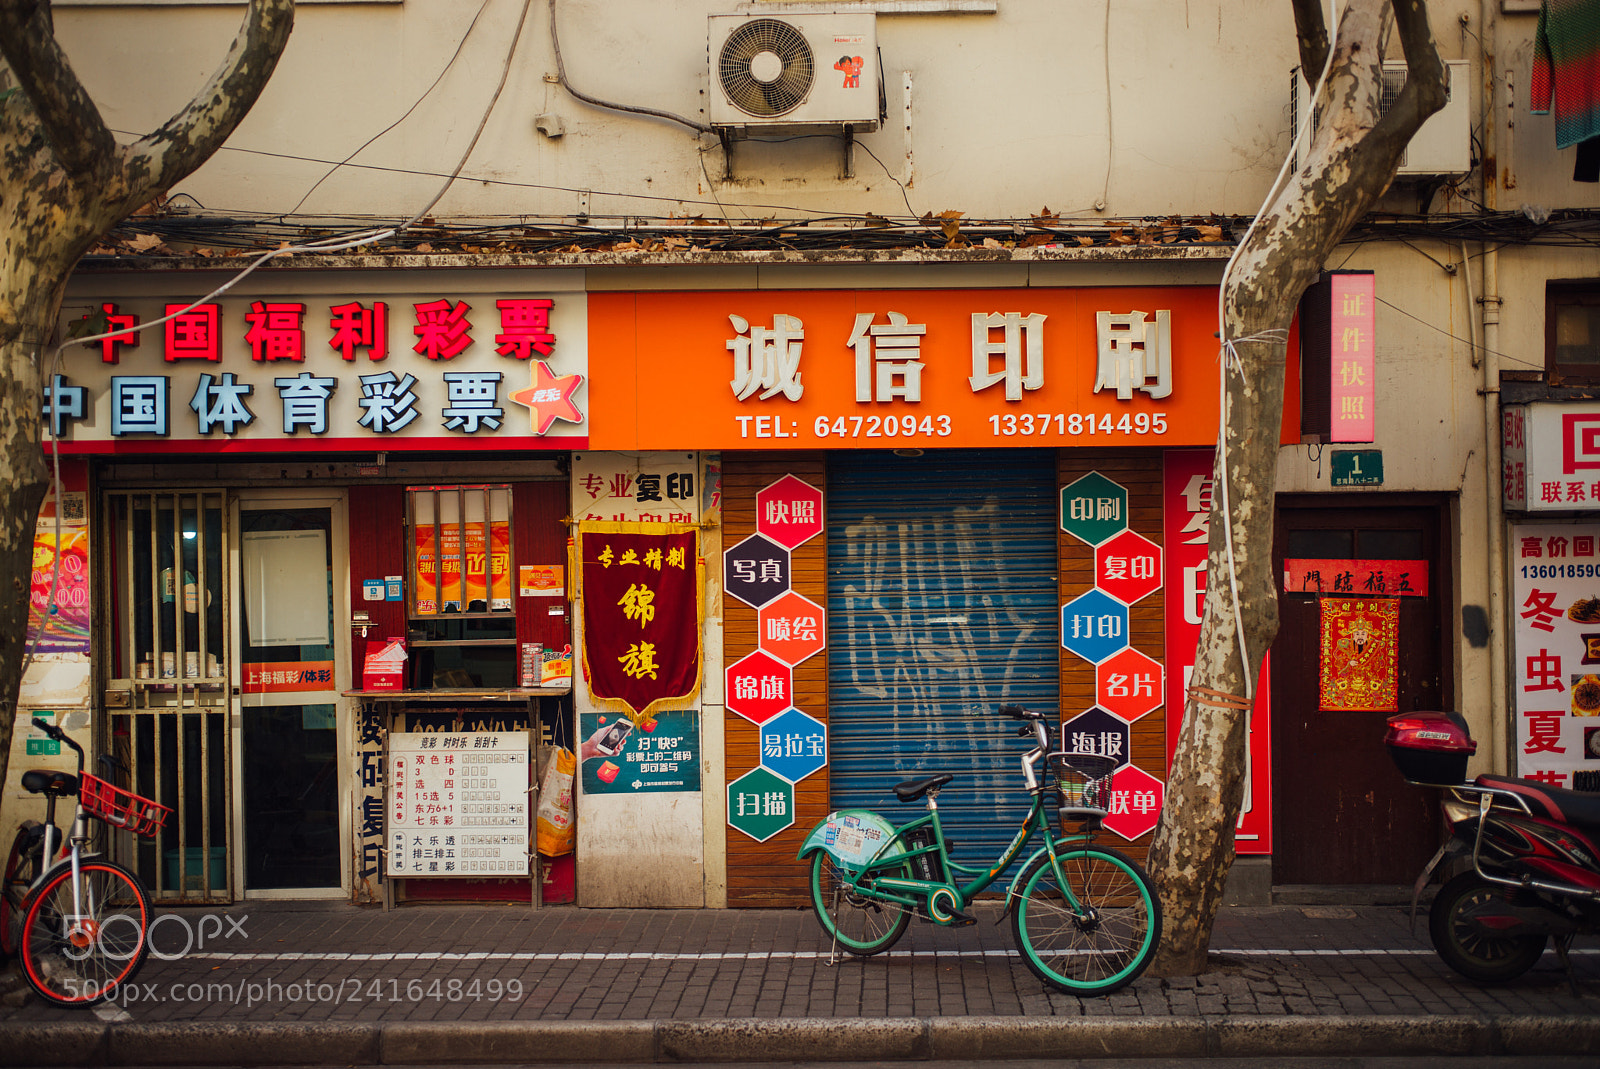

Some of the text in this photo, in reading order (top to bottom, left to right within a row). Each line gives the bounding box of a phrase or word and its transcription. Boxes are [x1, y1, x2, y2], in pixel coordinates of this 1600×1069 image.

[83, 299, 555, 364] 中国福利彩票
[726, 309, 1173, 403] 诚信印刷
[1340, 293, 1366, 420] 证件快照
[42, 371, 505, 437] 中国体育彩票
[735, 413, 1168, 438] TEL: 64720943 13371814495
[1351, 455, 1362, 475] 1
[766, 500, 815, 525] 快照
[1070, 497, 1120, 521] 印刷
[1521, 536, 1600, 558] 高价回
[733, 558, 783, 583] 写真
[1104, 555, 1154, 580] 复印
[767, 617, 817, 641] 喷绘
[1070, 614, 1121, 638] 打印
[246, 669, 331, 685] 上海福彩/体彩
[735, 675, 784, 700] 锦旗
[1106, 673, 1156, 697] 名片
[420, 737, 498, 748] 竞彩 时时乐 刮刮卡
[764, 733, 824, 758] 易拉宝
[1071, 731, 1122, 756] 海报
[415, 755, 454, 765] 双色球
[626, 751, 692, 762] 彩票上的二维码
[736, 792, 786, 816] 扫描
[1108, 790, 1157, 815] 联单
[414, 816, 454, 826] 七乐彩
[412, 835, 455, 846] 大乐透
[412, 848, 455, 859] 排三排五
[412, 861, 455, 872] 七星彩
